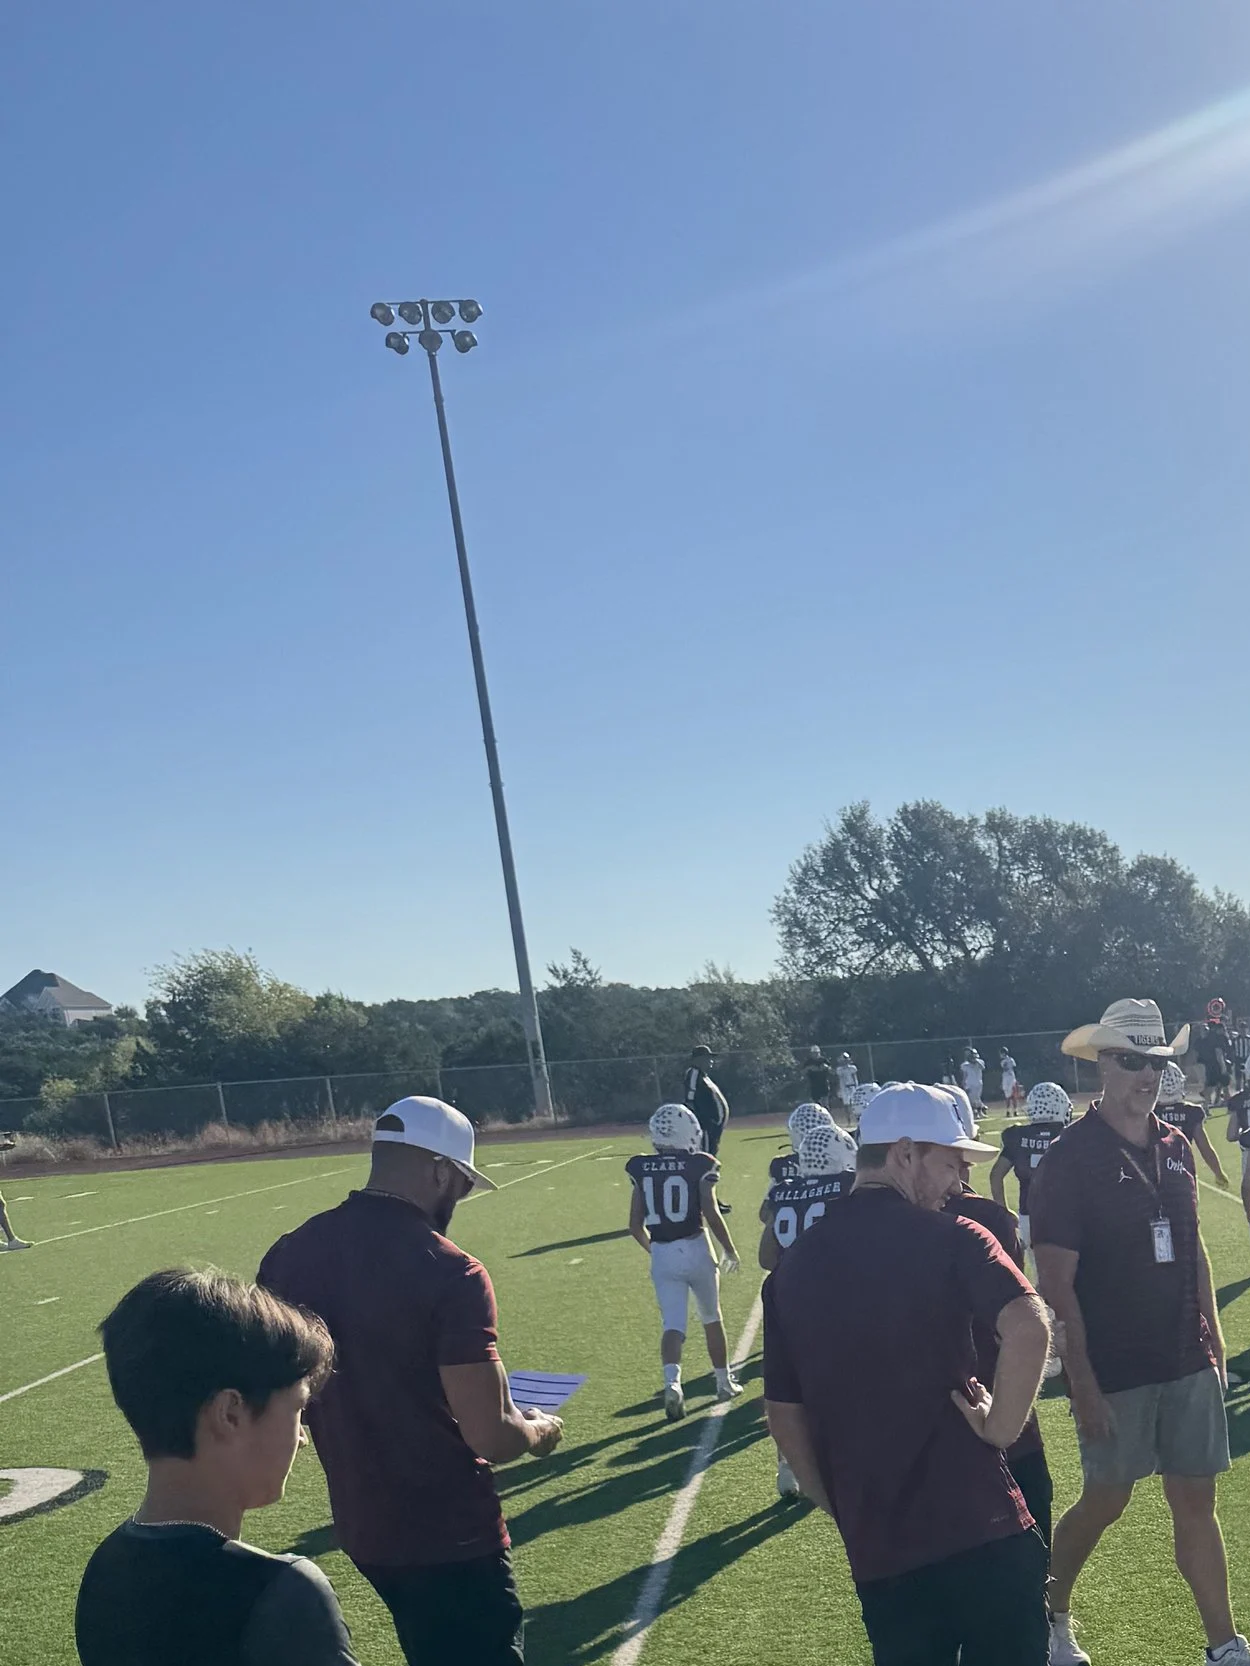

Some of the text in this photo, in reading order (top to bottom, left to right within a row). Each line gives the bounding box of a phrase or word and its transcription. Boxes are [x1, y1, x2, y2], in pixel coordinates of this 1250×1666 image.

[642, 1161, 687, 1172] CLARK
[642, 1175, 689, 1226] 10
[775, 1181, 841, 1202] GALLAGHER
